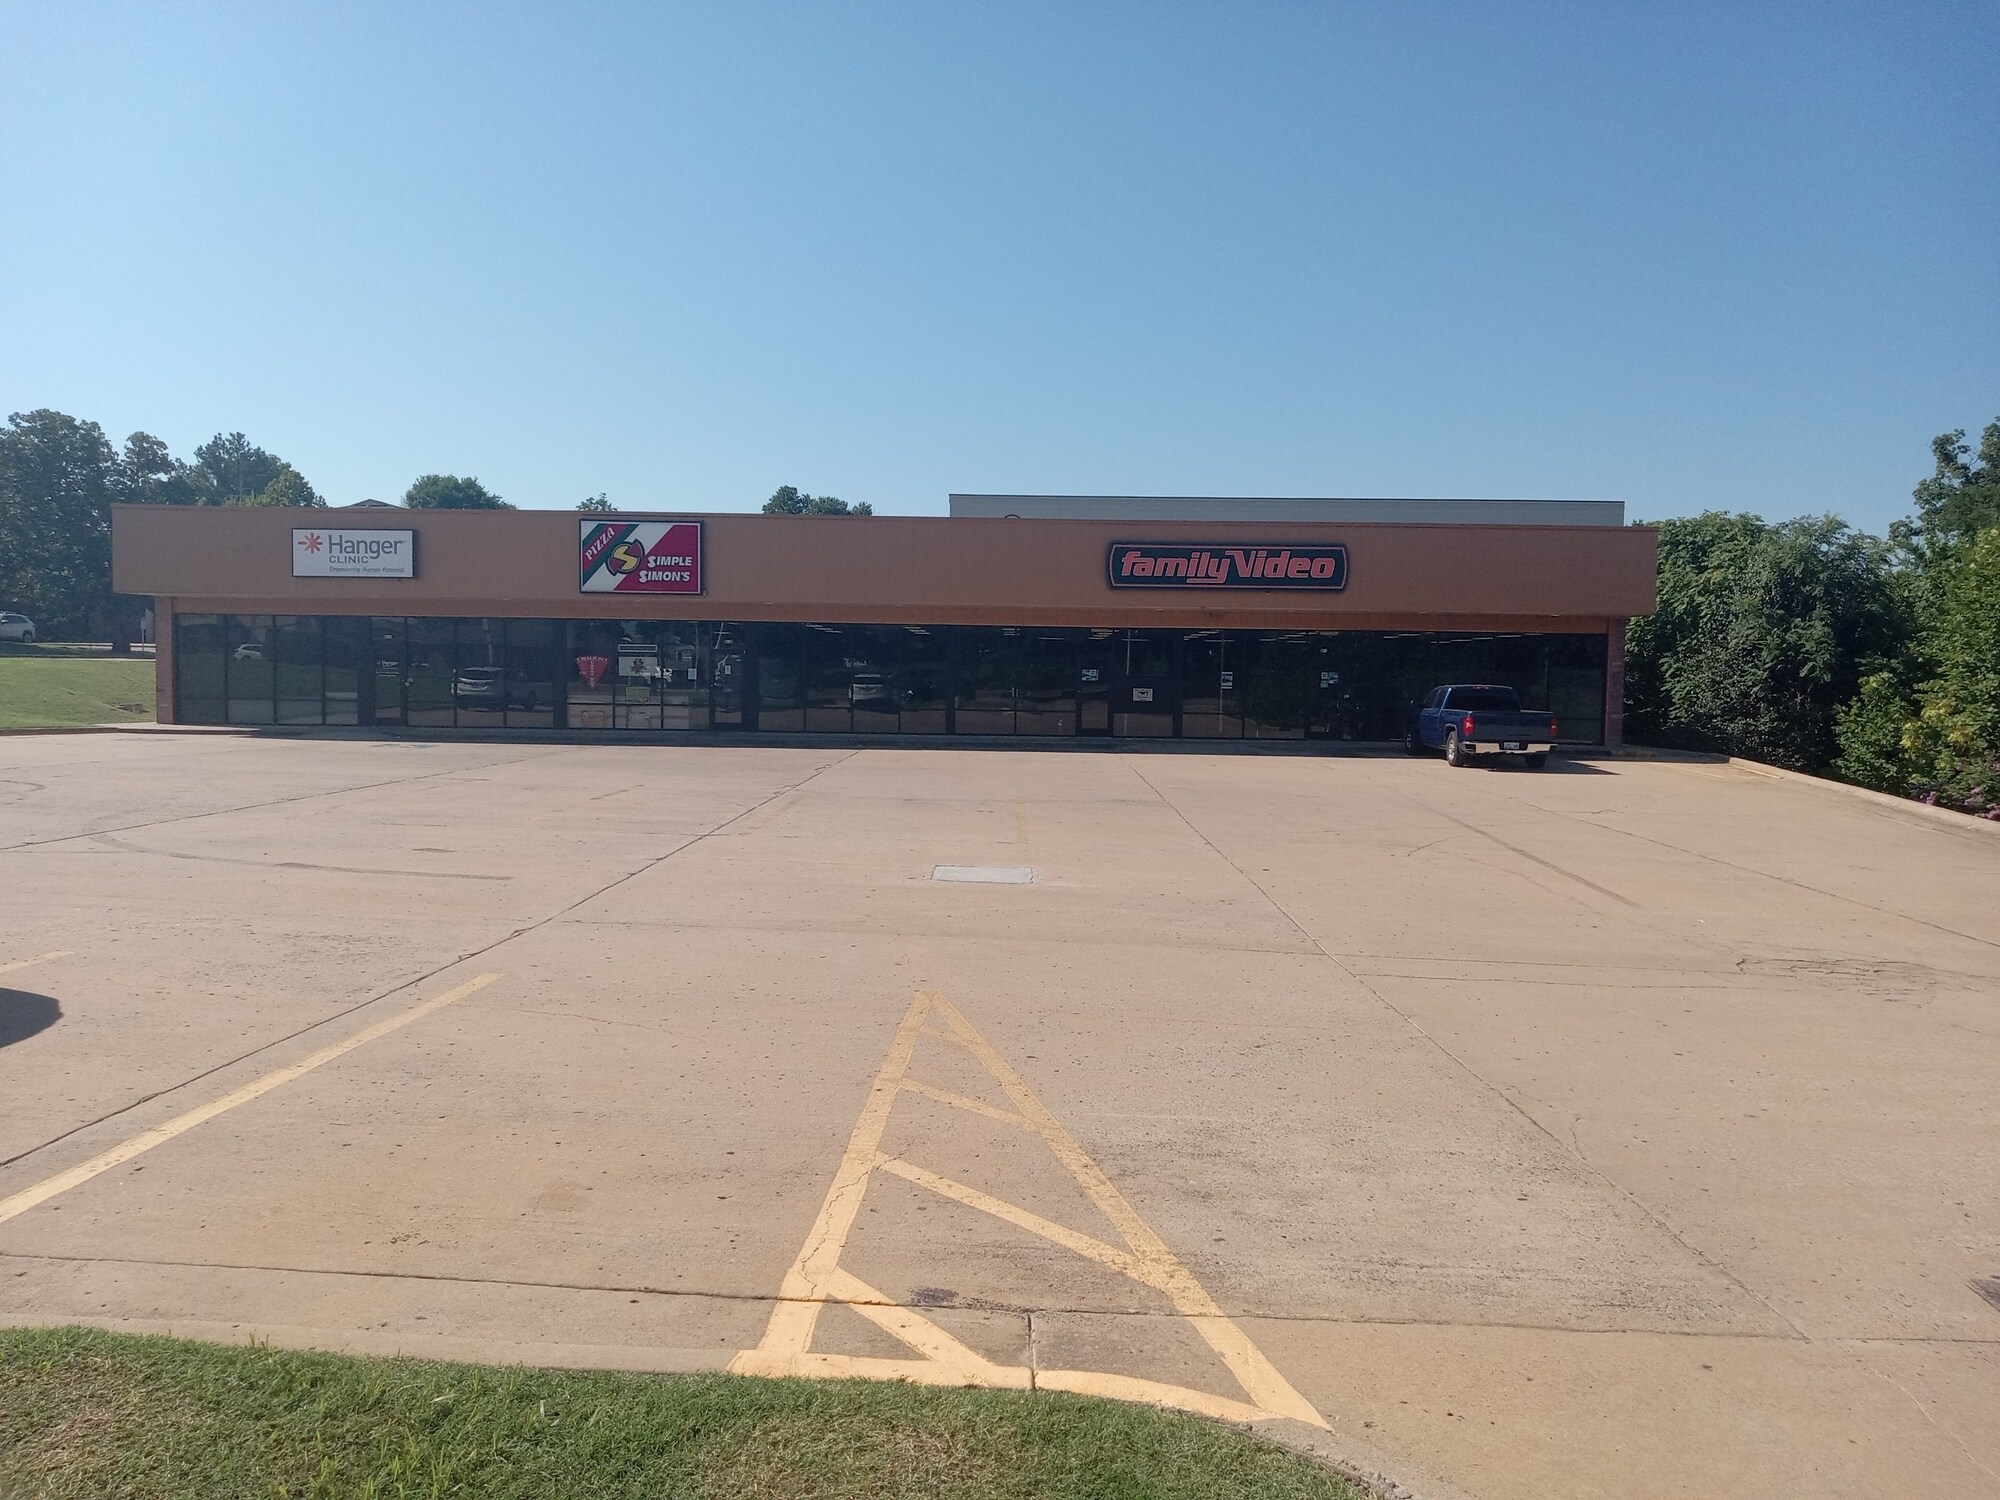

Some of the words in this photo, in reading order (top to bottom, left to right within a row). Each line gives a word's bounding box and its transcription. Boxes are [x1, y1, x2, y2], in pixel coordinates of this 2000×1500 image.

[328, 534, 404, 560] Hanger
[584, 526, 615, 561] PIZZA
[329, 555, 369, 564] CLINIC
[647, 555, 693, 568] SIMPLE
[639, 570, 691, 583] SIMON'S
